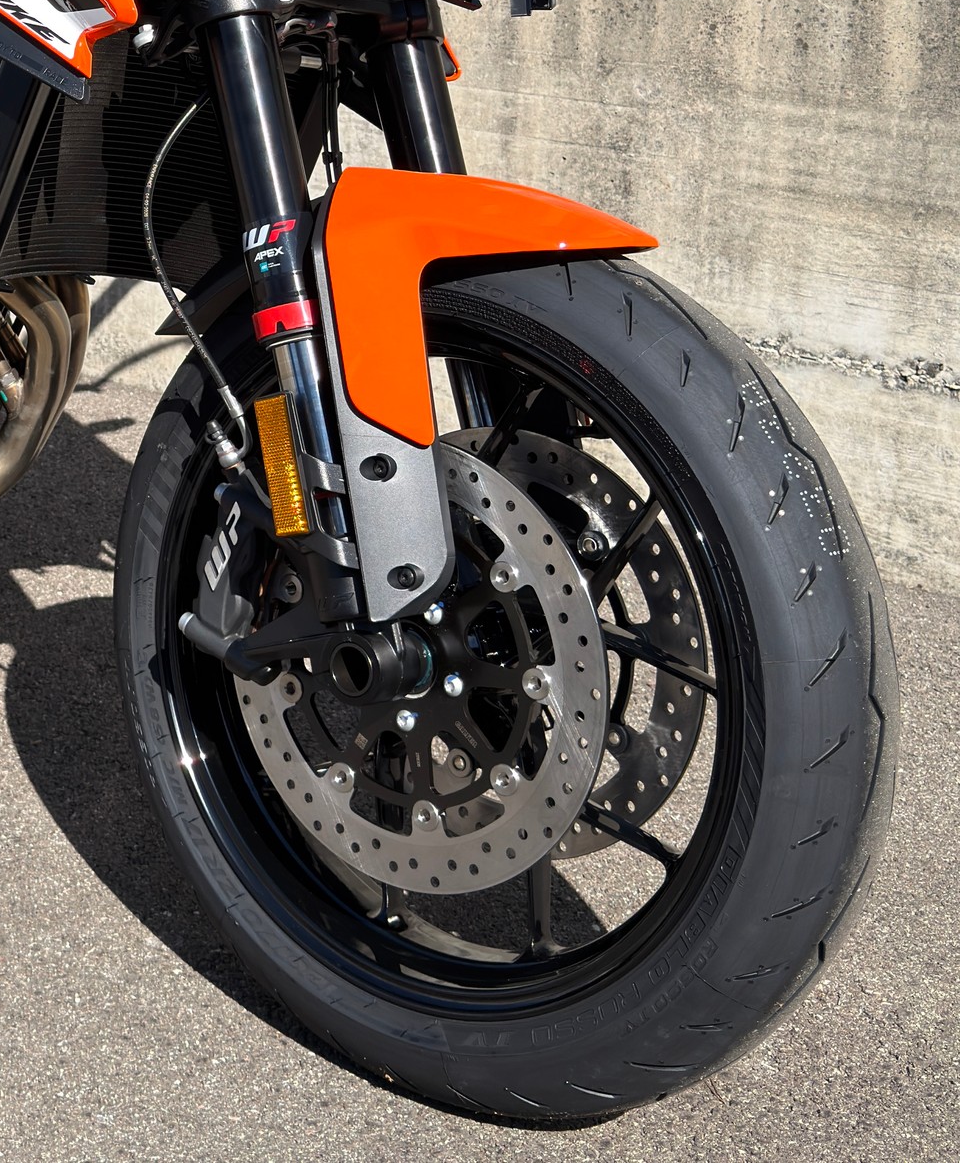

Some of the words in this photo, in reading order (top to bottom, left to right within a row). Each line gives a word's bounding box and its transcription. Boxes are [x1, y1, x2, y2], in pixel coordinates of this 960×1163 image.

[242, 218, 297, 253] WP
[253, 245, 285, 263] APEX
[203, 502, 242, 592] WP
